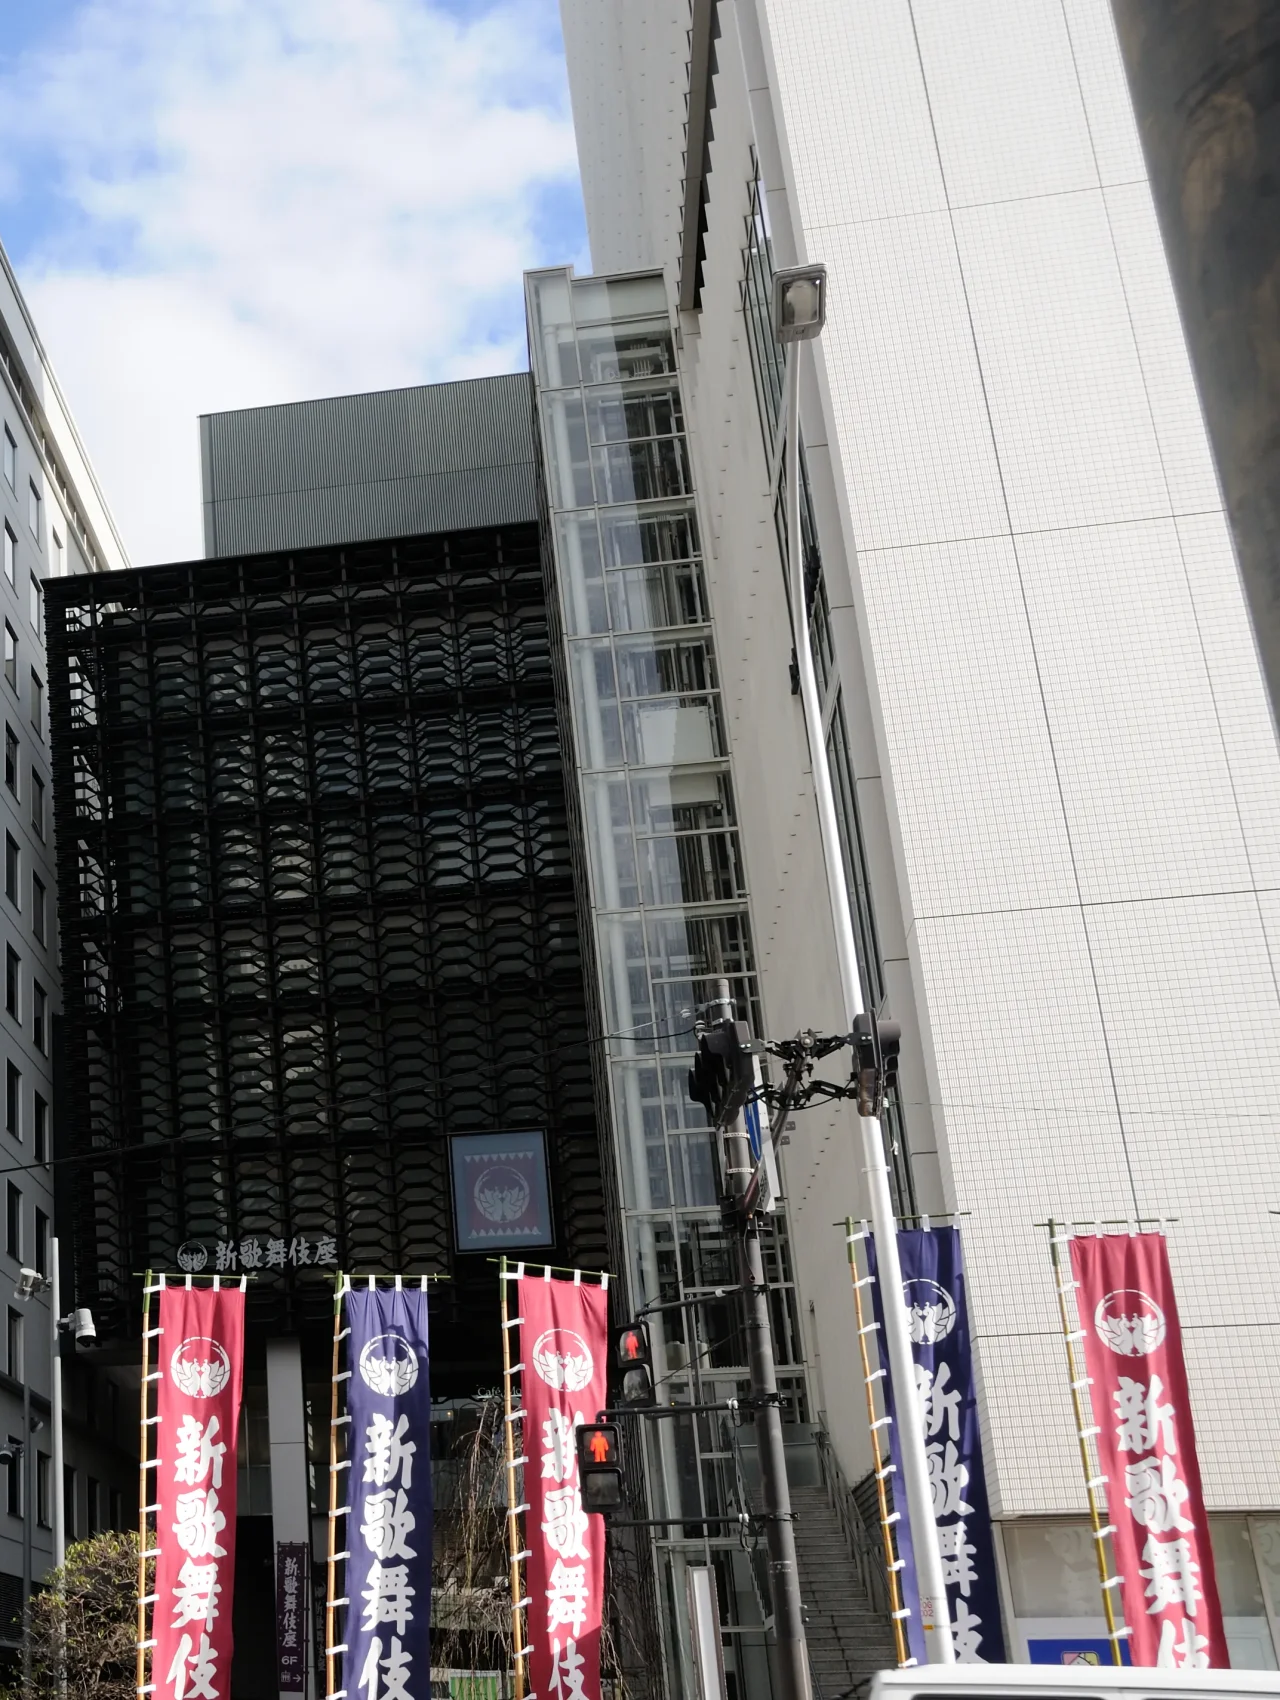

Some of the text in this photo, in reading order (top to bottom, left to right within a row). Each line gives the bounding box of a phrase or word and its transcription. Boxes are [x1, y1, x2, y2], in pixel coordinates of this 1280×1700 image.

[215, 1235, 339, 1272] 新歌舞伎座
[166, 1414, 228, 1700] 新歌舞伎
[282, 1556, 299, 1648] 新歌舞伎座
[358, 1412, 418, 1700] 新歌舞伎
[540, 1407, 591, 1700] 新歌舞伎
[281, 1655, 298, 1665] 6F
